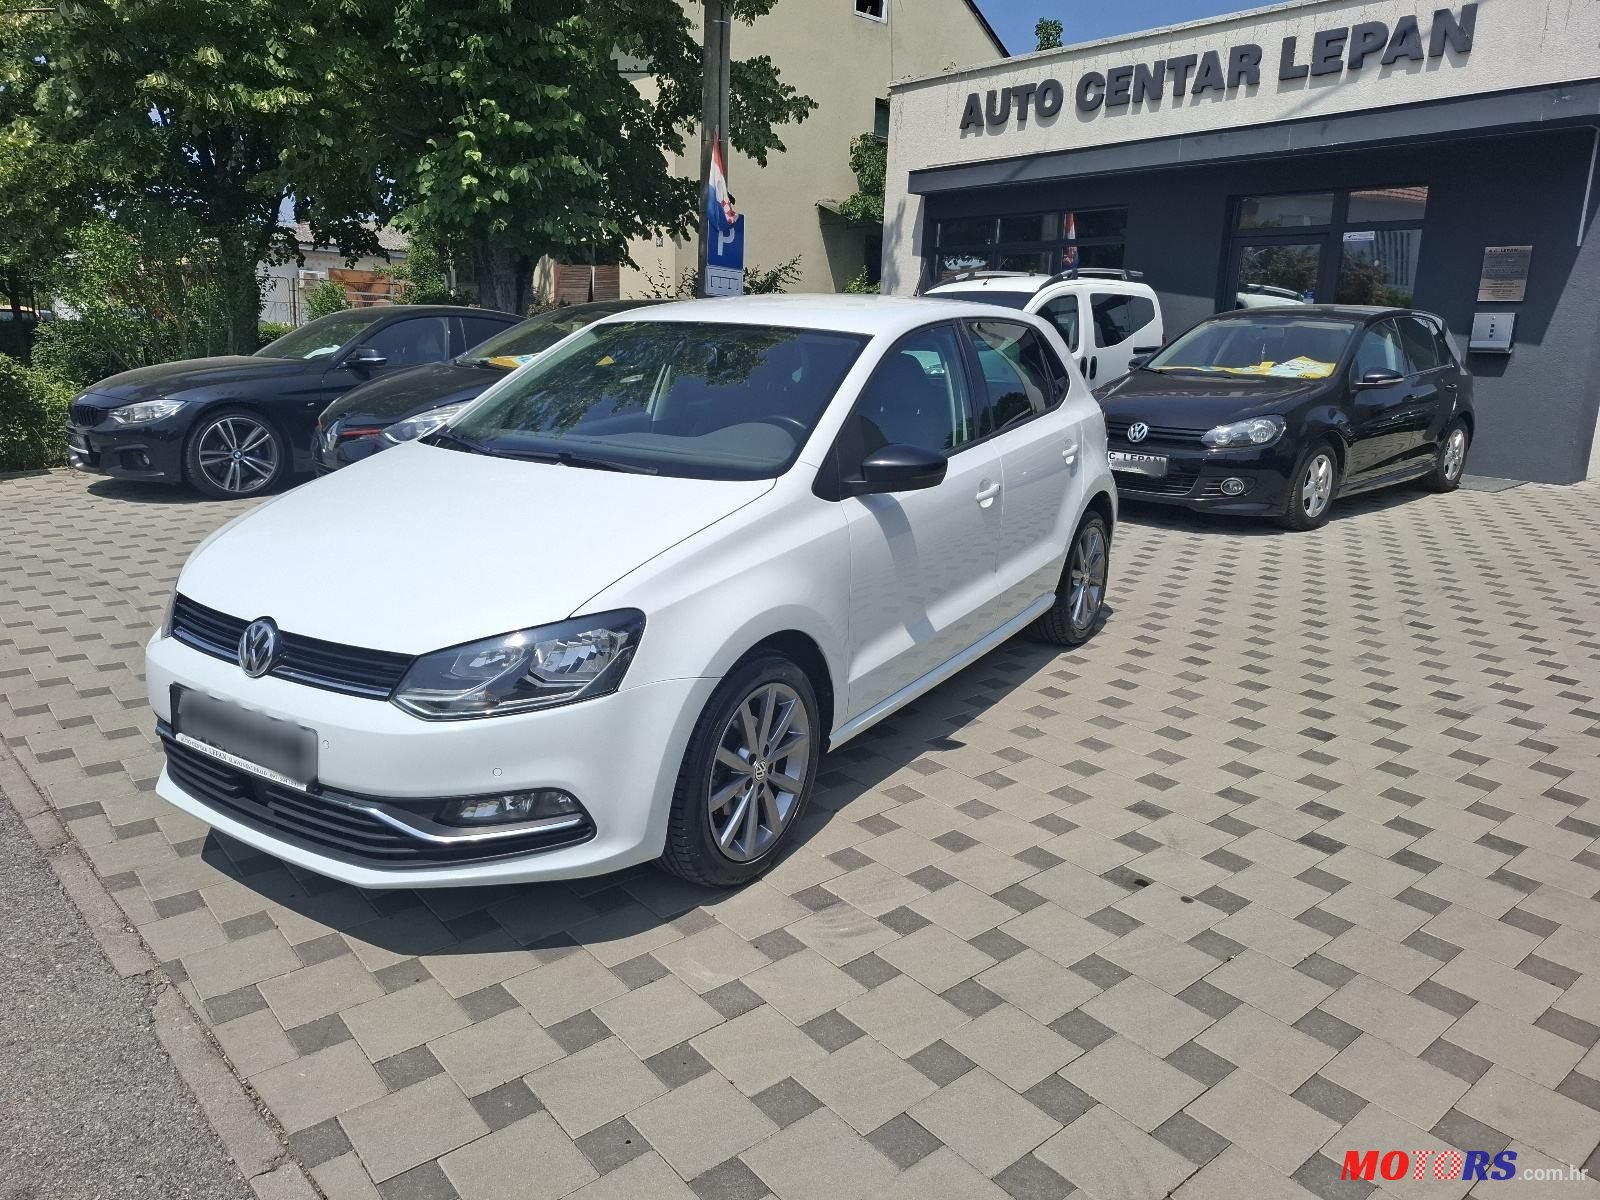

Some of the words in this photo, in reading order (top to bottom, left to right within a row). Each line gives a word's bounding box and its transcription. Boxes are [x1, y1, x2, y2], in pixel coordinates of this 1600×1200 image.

[960, 78, 1064, 130] AUTO
[1076, 43, 1263, 112] CENTAR
[1278, 3, 1479, 81] LEPAN
[717, 227, 736, 257] P
